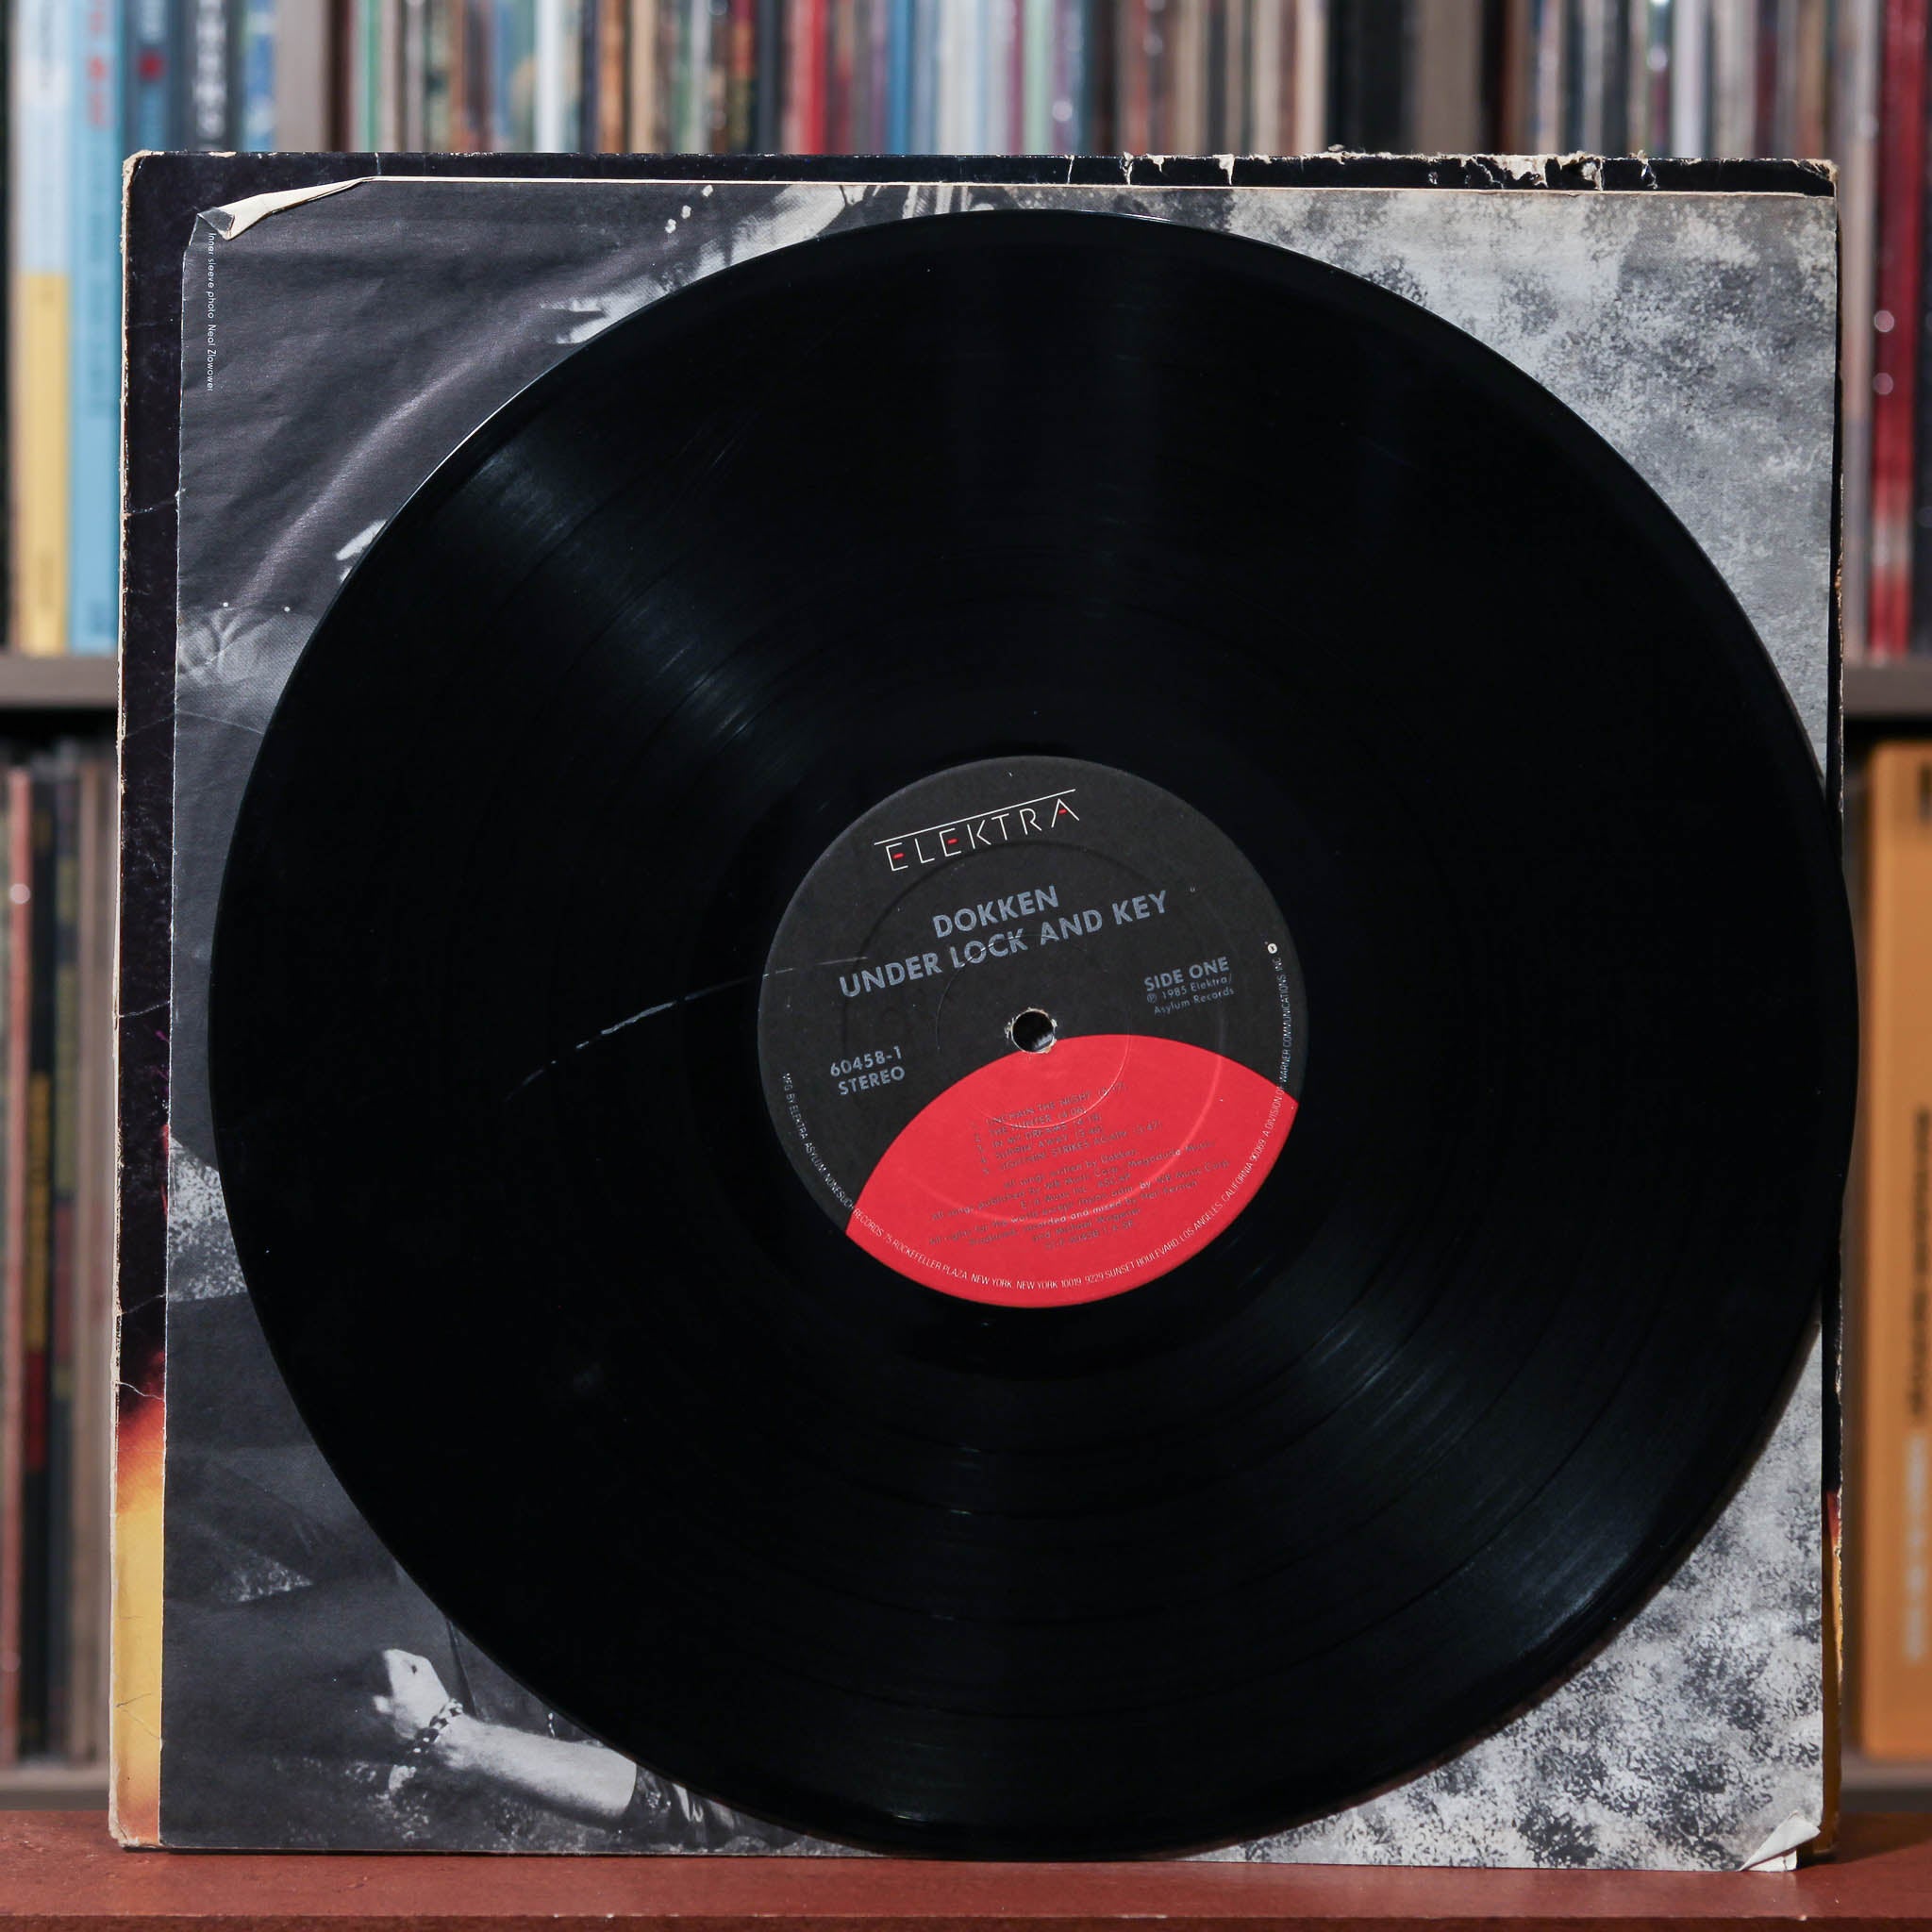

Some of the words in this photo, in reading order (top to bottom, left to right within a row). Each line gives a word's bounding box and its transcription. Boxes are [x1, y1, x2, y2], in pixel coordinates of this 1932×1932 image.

[208, 232, 217, 255] Inner
[208, 258, 217, 288] sleeve
[207, 324, 217, 346] Neal
[206, 349, 217, 391] Zlowower
[884, 794, 1080, 872] ELEKTRA
[933, 886, 1058, 937] DOKKEN
[839, 952, 941, 997] UNDER
[950, 928, 1026, 968] LOCK
[1037, 908, 1102, 944] AND
[1111, 889, 1172, 924] KEY
[1144, 969, 1183, 991] SIDE
[1188, 956, 1229, 978] ONE
[1153, 997, 1190, 1016] Asylum
[1193, 986, 1234, 1004] Records
[1162, 985, 1186, 999] 1985
[1277, 974, 1290, 1046] COMMUNICATIONS
[828, 1045, 901, 1077] 60458-1
[1278, 1049, 1290, 1081] WARNER
[837, 1065, 907, 1095] STEREO
[1038, 1101, 1055, 1111] THE
[1265, 1095, 1281, 1128] DIVISION
[989, 1126, 1008, 1137] THE
[1051, 1141, 1090, 1157] STRIKES
[1139, 1180, 1151, 1189] by
[1221, 1161, 1253, 1202] CALIFORNIA
[1069, 1208, 1089, 1219] and
[1091, 1199, 1122, 1213] mixed
[1178, 1226, 1194, 1241] LOS
[891, 1239, 941, 1270] ROCKEFELLER
[1105, 1260, 1136, 1278] SUNSET
[971, 1274, 989, 1284] NEW
